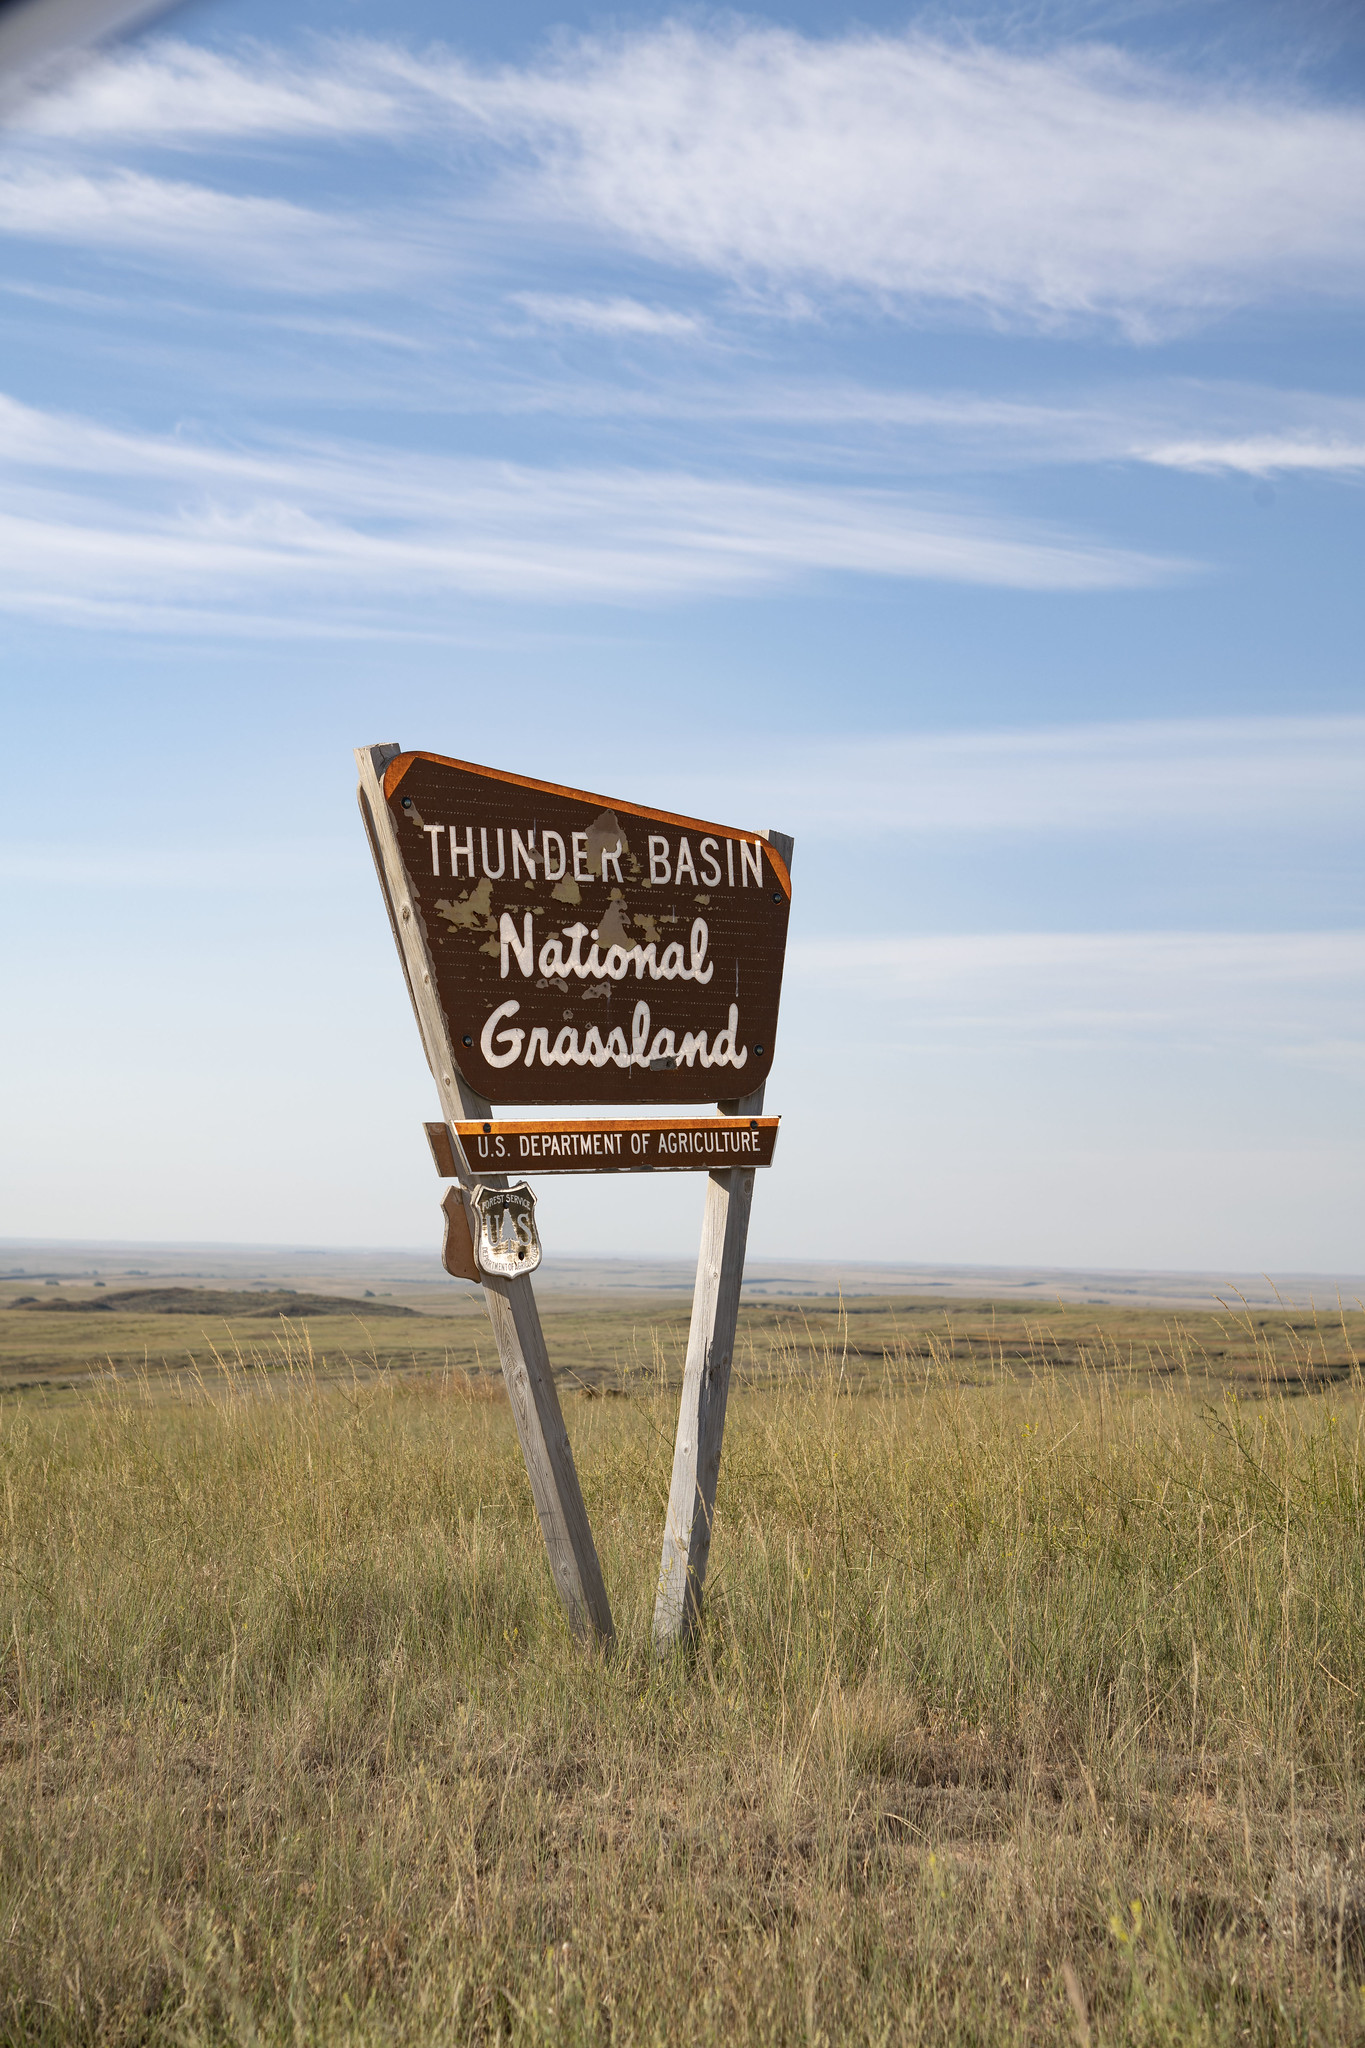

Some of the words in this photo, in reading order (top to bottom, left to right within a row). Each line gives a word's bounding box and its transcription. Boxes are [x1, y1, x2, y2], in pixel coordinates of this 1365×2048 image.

[423, 824, 624, 884] THUNDER
[648, 835, 763, 889] BASIN
[500, 912, 714, 984] National
[479, 999, 748, 1069] Grassland
[477, 1136, 511, 1158] U.S.
[519, 1133, 622, 1157] DEPARTMENT
[631, 1132, 650, 1155] OF
[658, 1131, 761, 1154] AGRICULTURE
[482, 1194, 505, 1212] FOREST
[505, 1194, 531, 1211] SERVICE
